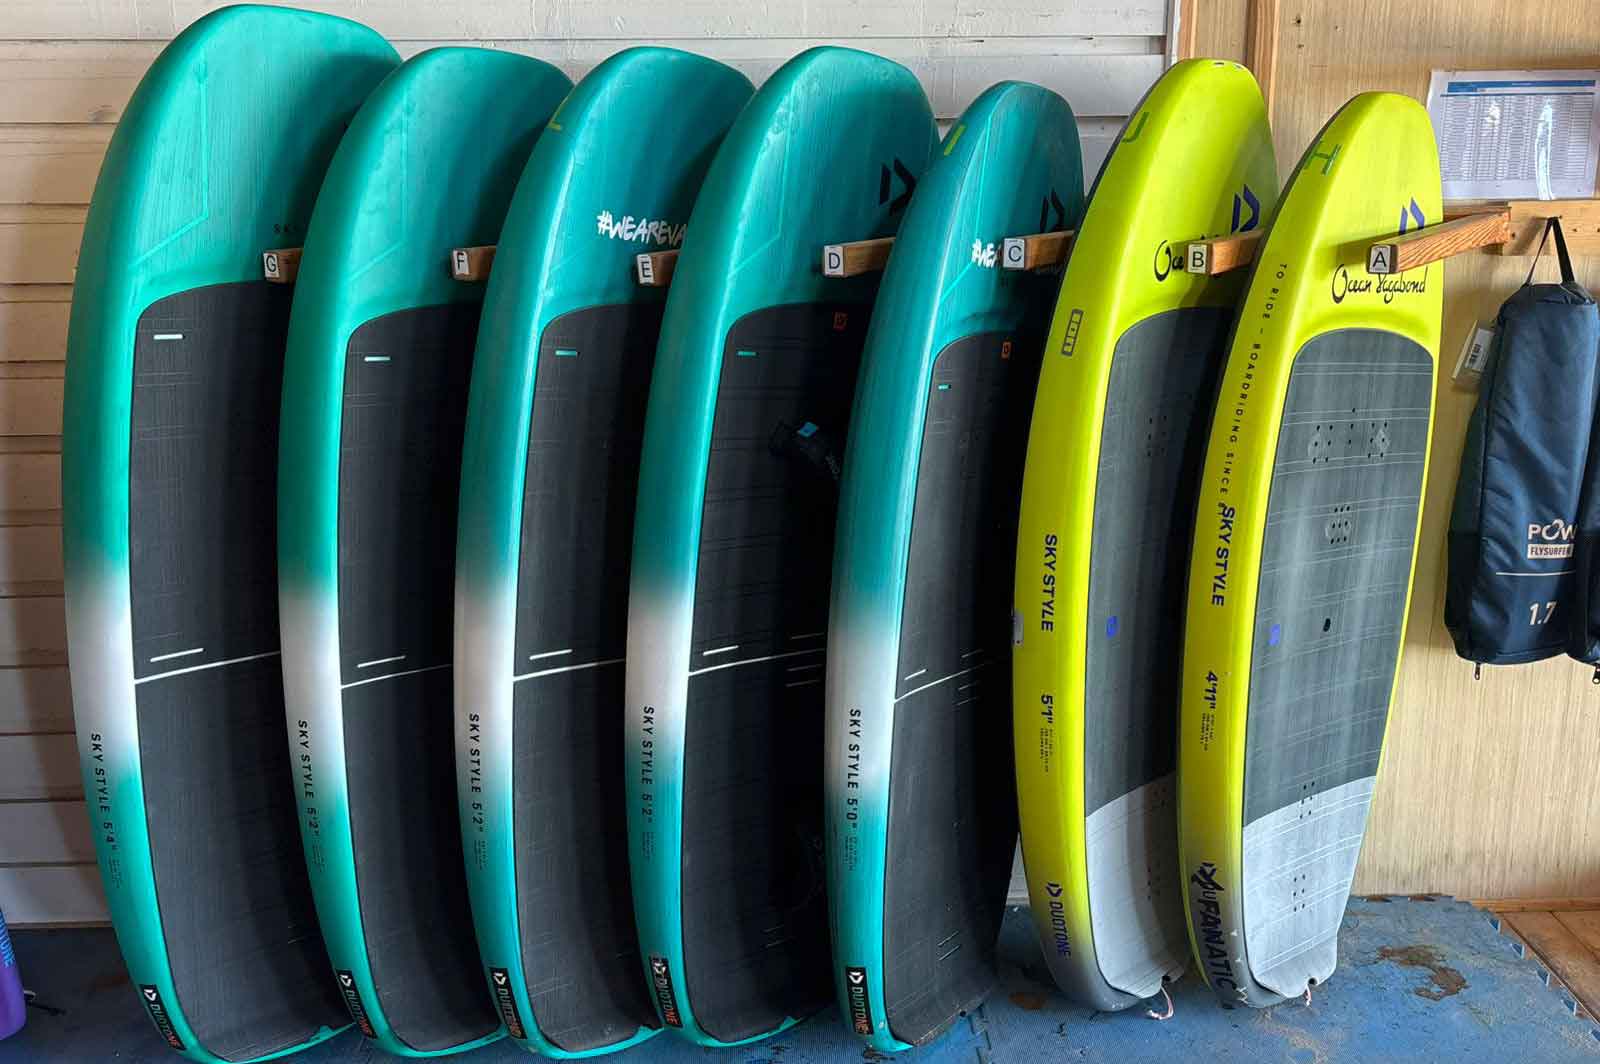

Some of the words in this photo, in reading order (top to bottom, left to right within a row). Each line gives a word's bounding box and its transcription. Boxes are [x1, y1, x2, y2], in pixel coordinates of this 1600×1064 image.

[266, 255, 277, 272] G
[456, 252, 465, 270] F
[828, 252, 841, 270] D
[1008, 245, 1022, 262] C
[1192, 251, 1205, 268] B
[1372, 250, 1387, 267] A
[641, 261, 652, 278] E
[1276, 263, 1288, 279] TO
[1332, 263, 1371, 304] Ocean
[1219, 507, 1236, 544] SKY
[1043, 534, 1057, 571] SKY
[1212, 547, 1230, 607] STYLE
[1041, 574, 1056, 632] STYLE
[1529, 600, 1557, 625] 1.7
[298, 719, 309, 749] SKY
[469, 713, 480, 742] SKY
[643, 706, 654, 735] SKY
[849, 709, 861, 737] SKY
[91, 733, 104, 763] SKY
[641, 740, 653, 785] STYLE
[301, 754, 314, 799] STYLE
[470, 748, 481, 793] STYLE
[847, 744, 859, 789] STYLE
[95, 767, 111, 814] STYLE
[1049, 901, 1072, 960] DUOTONE
